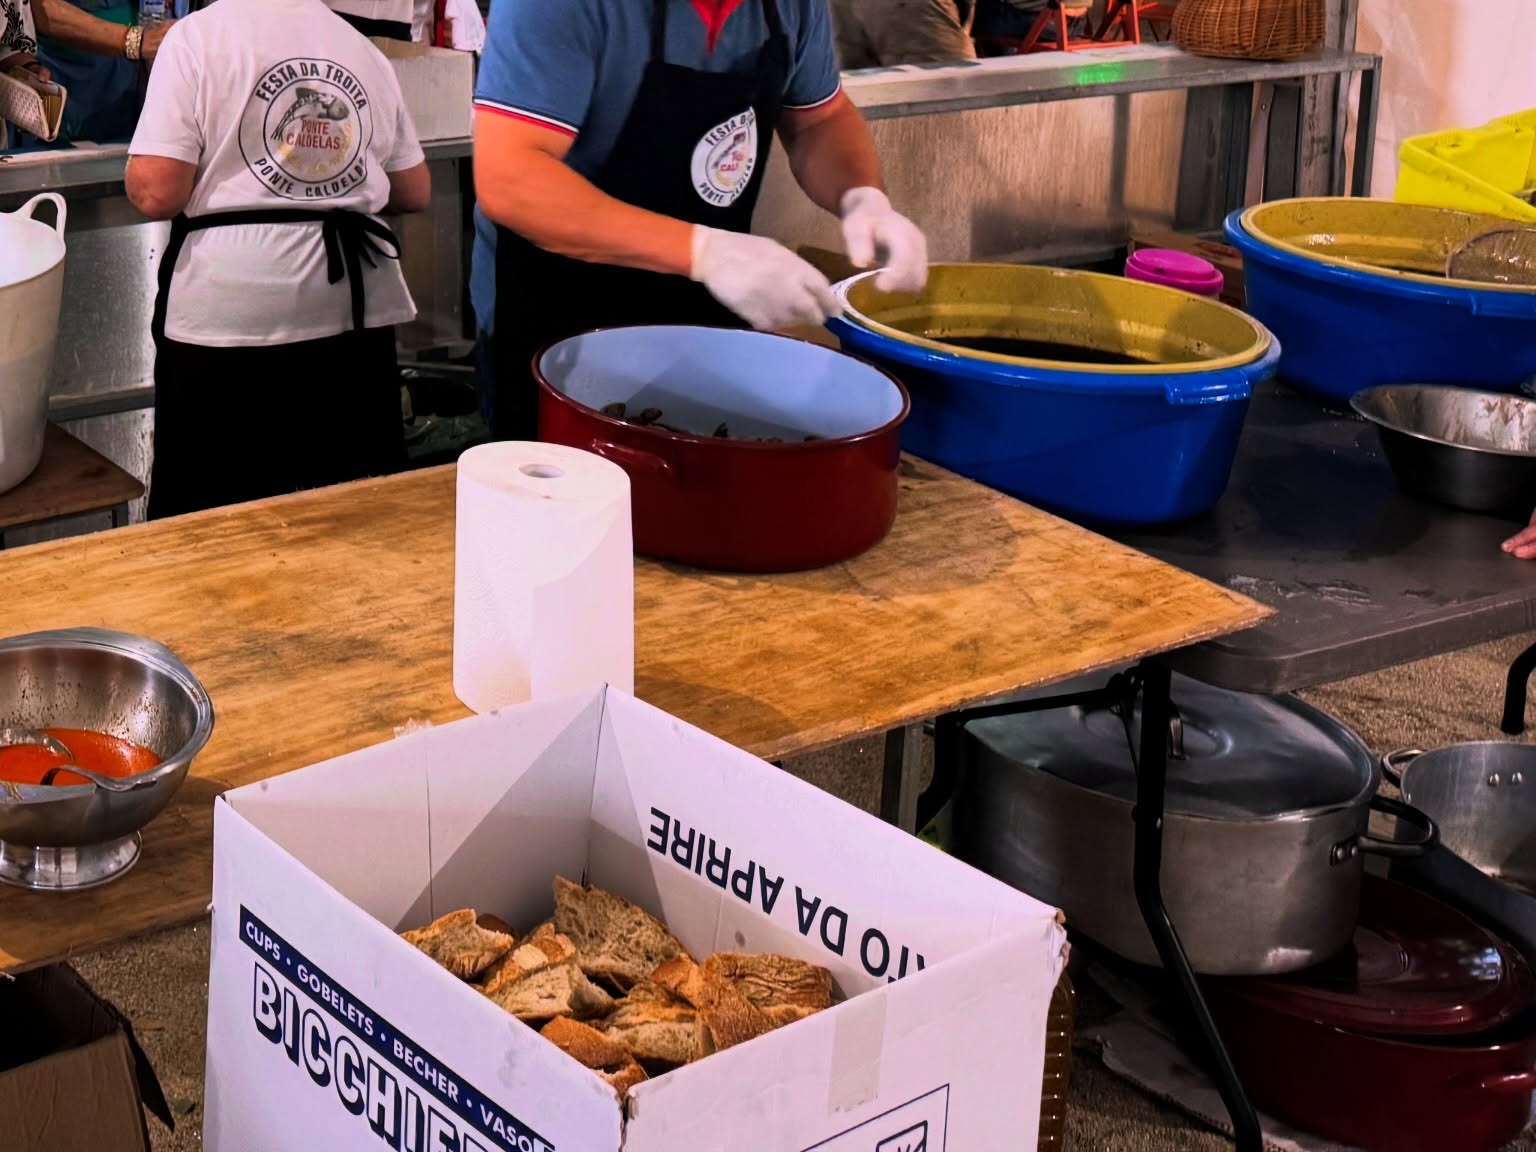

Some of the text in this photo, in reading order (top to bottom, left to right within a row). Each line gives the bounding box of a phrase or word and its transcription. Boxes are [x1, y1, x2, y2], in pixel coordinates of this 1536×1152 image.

[256, 62, 367, 110] FESTA DA TROITA
[286, 132, 340, 150] CALDELAS
[301, 120, 330, 135] PONTE
[705, 120, 736, 146] FESTA
[254, 158, 294, 194] PONTE
[647, 807, 785, 915] APRIRE
[795, 885, 848, 956] DA
[246, 921, 281, 961] CUPS
[297, 965, 374, 1036] GOBELETS
[393, 1039, 459, 1103] BECHER
[253, 961, 498, 1152] BICCHIE
